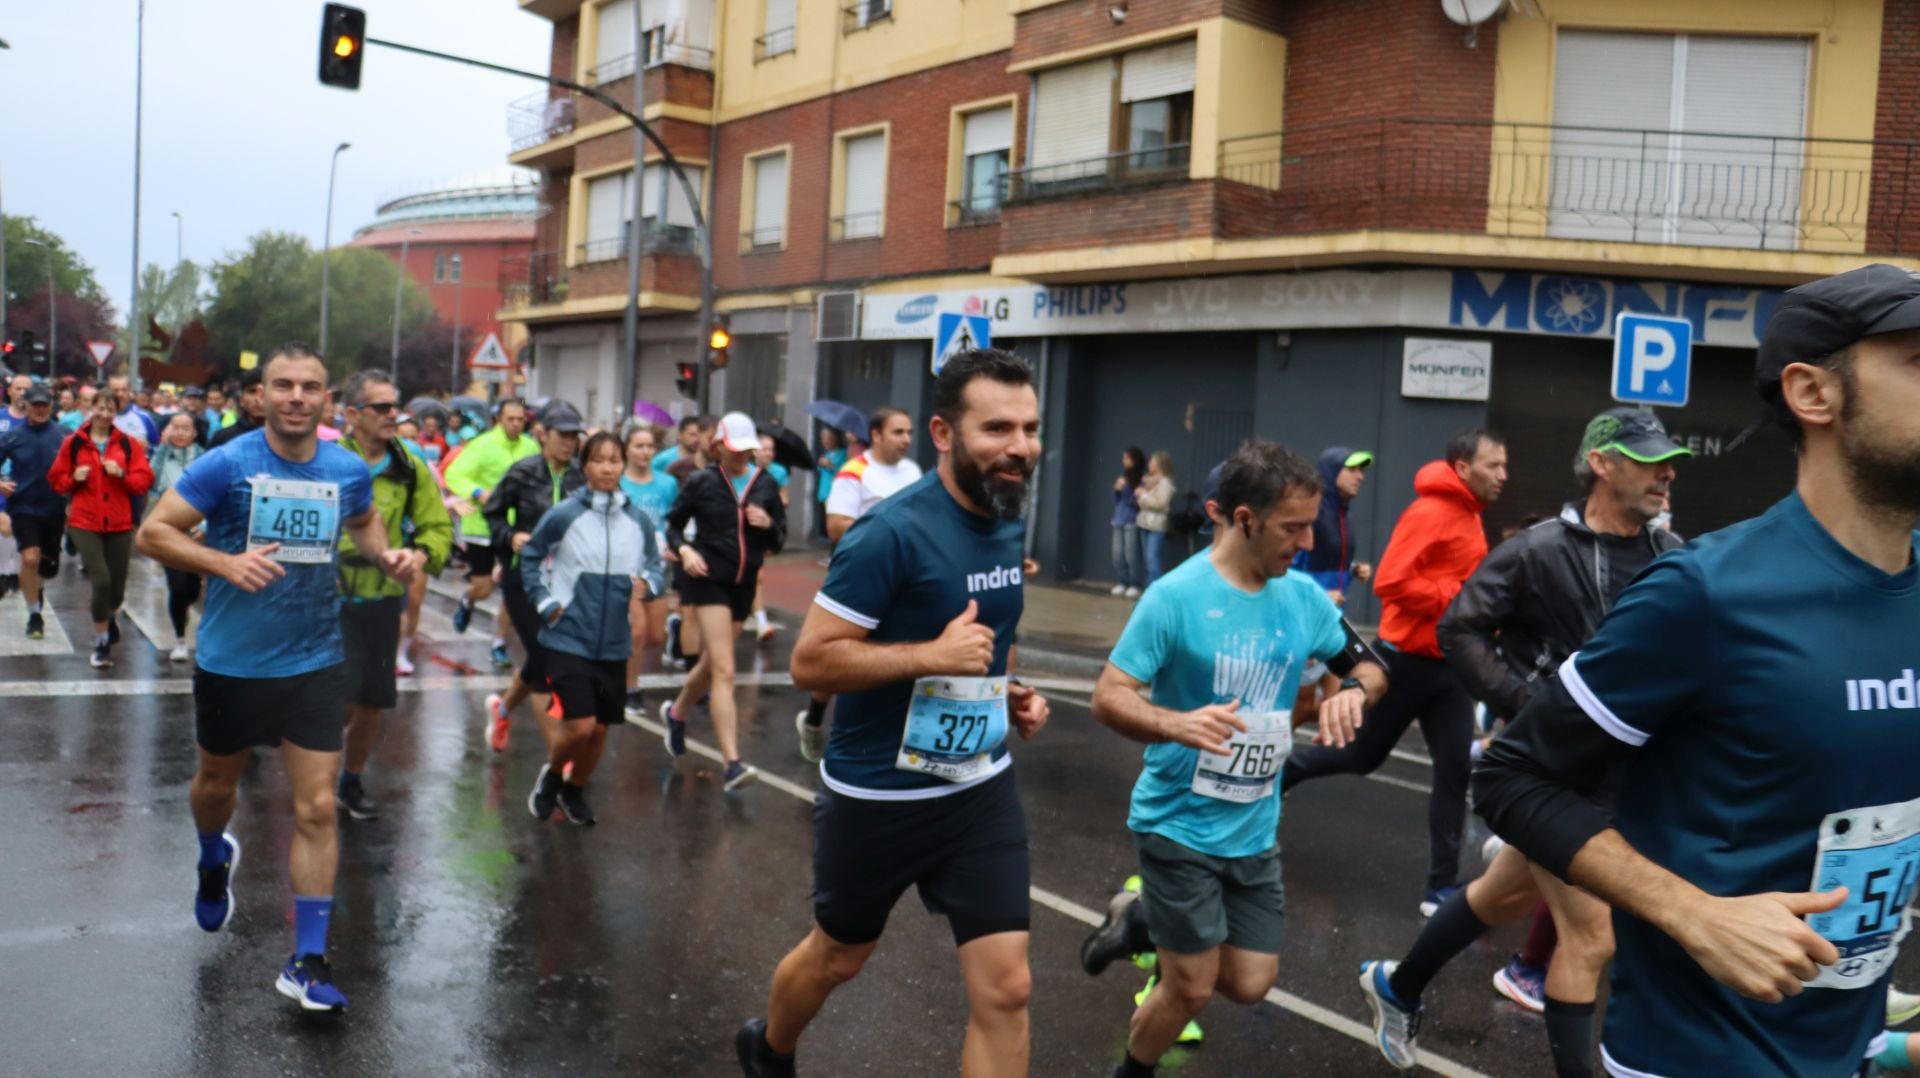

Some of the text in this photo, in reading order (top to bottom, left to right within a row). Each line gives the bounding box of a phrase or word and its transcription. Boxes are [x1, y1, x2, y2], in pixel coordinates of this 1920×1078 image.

[1033, 284, 1127, 318] PHILIPS
[1154, 282, 1228, 314] JVC
[1261, 276, 1380, 306] SONY
[1451, 271, 1773, 343] MONF
[983, 295, 1010, 321] LG
[1408, 362, 1486, 378] MONFER
[1631, 326, 1676, 392] P
[272, 509, 319, 537] 489
[934, 712, 989, 753] 327
[1227, 743, 1275, 775] 766
